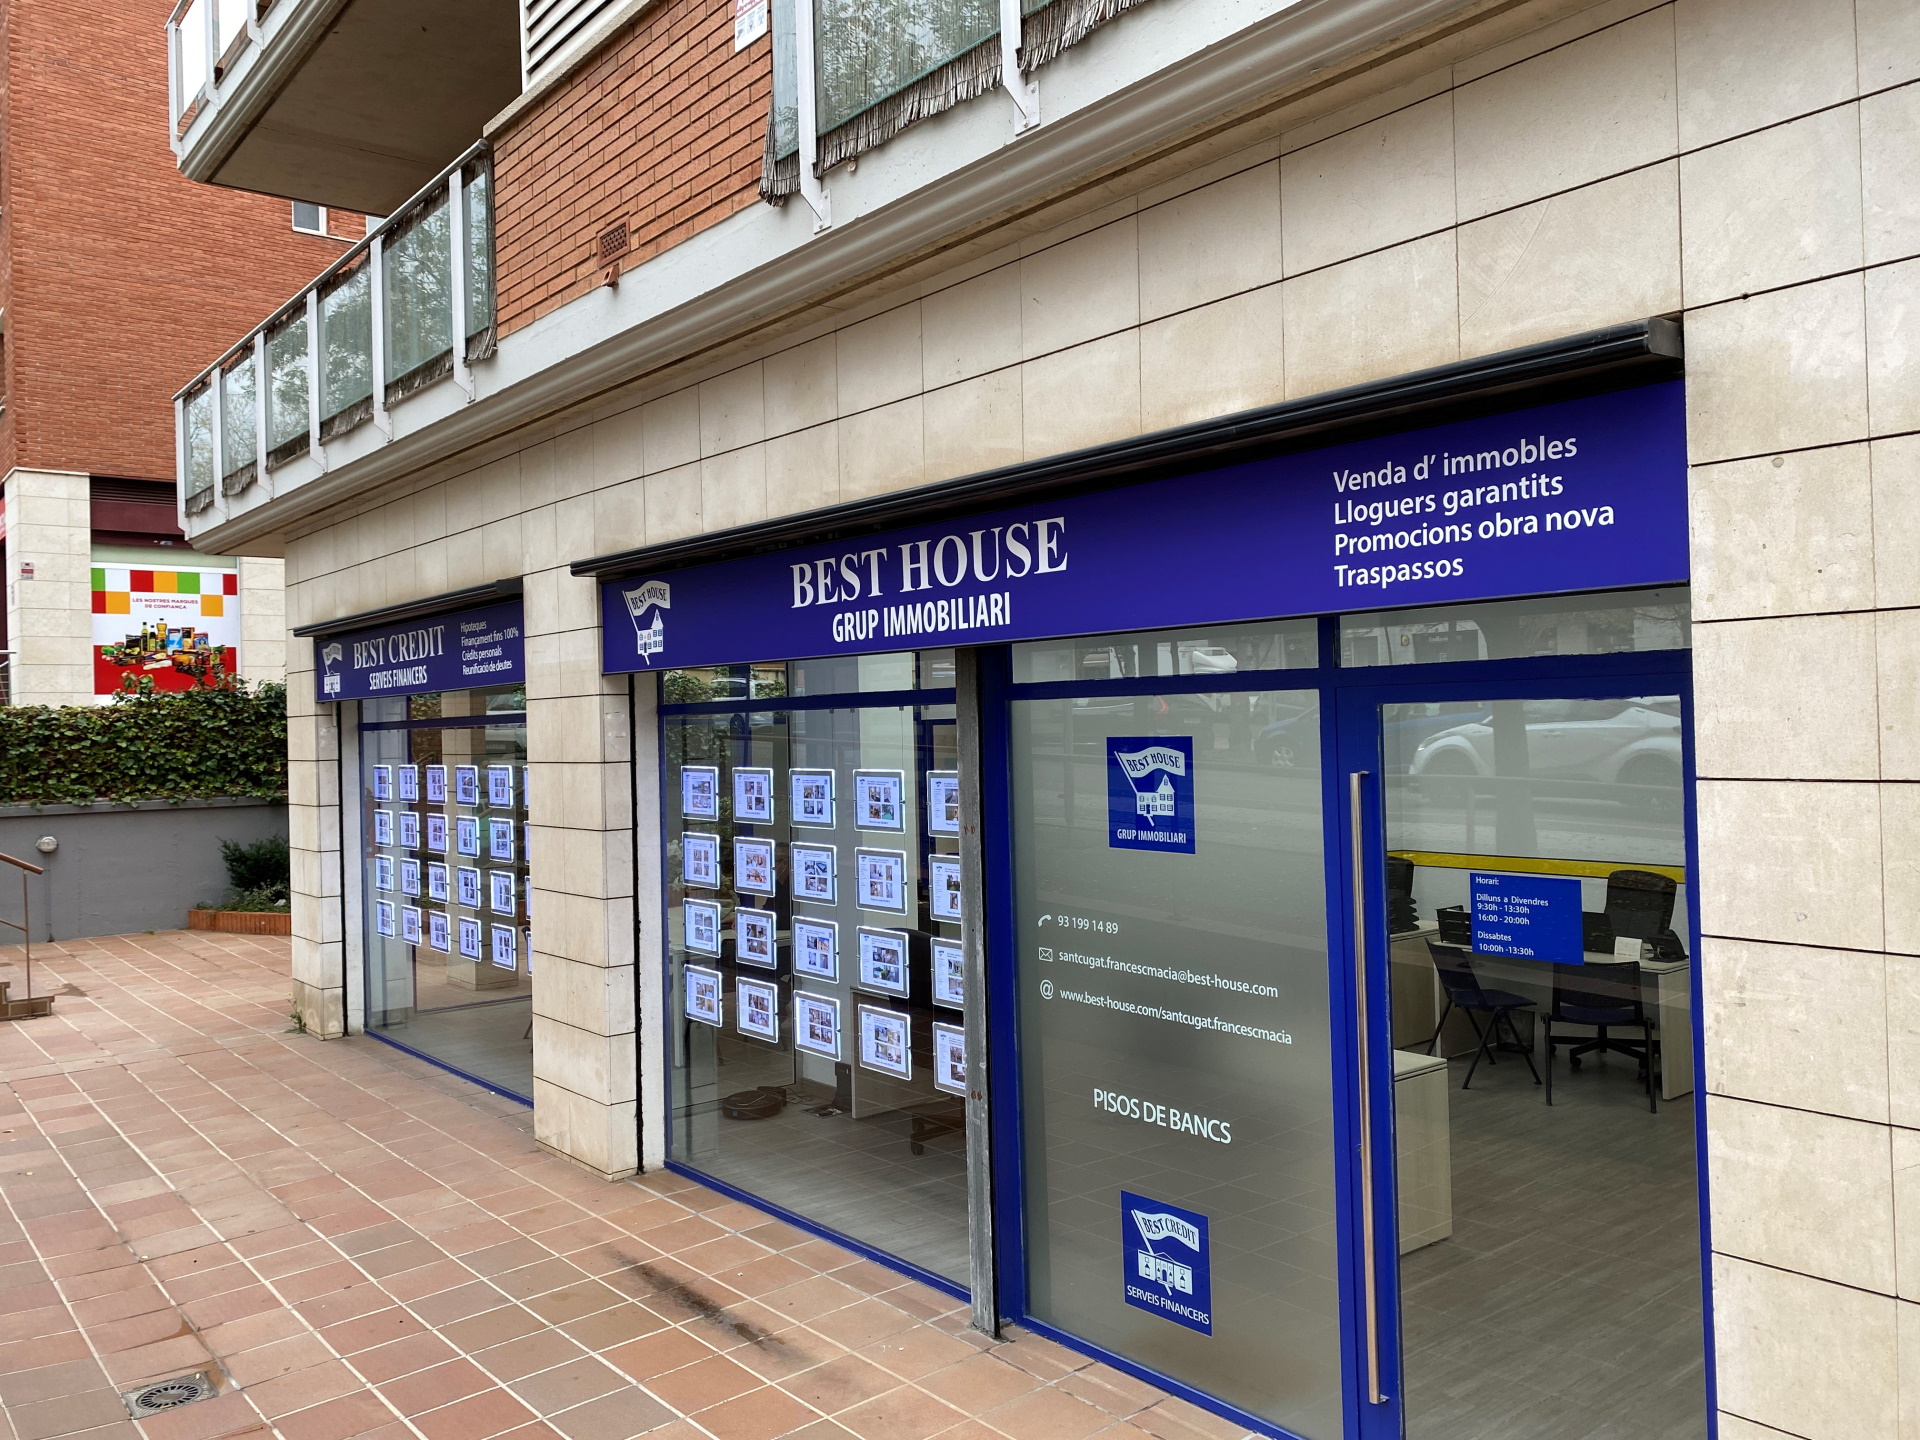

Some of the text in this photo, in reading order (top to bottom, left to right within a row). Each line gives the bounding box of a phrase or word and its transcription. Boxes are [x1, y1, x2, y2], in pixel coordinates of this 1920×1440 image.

[1333, 461, 1406, 493] Venda
[1443, 436, 1577, 476] immobles
[1334, 473, 1563, 525] Lloguers garantits
[1335, 505, 1614, 556] Promocions obra nova
[790, 517, 1068, 608] BEST HOUSE
[1334, 557, 1463, 589] Traspassos
[630, 587, 666, 610] BEST HOUSE
[460, 621, 486, 634] Hipoteques
[832, 592, 1010, 642] GRUP IMMOBILIARI
[353, 638, 385, 669] BEST
[388, 625, 444, 663] CREDIT
[461, 627, 518, 648] Finançament fins 100%
[479, 645, 502, 661] personals
[370, 665, 427, 690] SERVEIS FINANCERS
[490, 661, 495, 672] de
[496, 660, 512, 671] deutes
[1126, 753, 1180, 771] BEST HOUSE
[1117, 829, 1186, 844] GRUP IMMOBILIARI
[1476, 893, 1501, 902] Dilluns
[1511, 896, 1548, 906] Divendres
[1477, 903, 1498, 911] 9:30h
[1505, 905, 1530, 914] 13:30h
[1058, 915, 1118, 934] 93 199 14 89
[1478, 914, 1498, 922] 16:00
[1504, 916, 1530, 925] 20:00h
[1478, 931, 1512, 941] Dissabtes
[1479, 944, 1503, 953] 10:00h
[1059, 952, 1278, 998] santcugat.francescmacia@best-house.com
[1060, 990, 1292, 1045] www.best-house.com/santcugat.francescmacia
[1094, 1088, 1232, 1144] PISOS DE BANCS
[1141, 1217, 1196, 1244] BEST CREDIT
[1127, 1285, 1209, 1324] SERVEIS FINANCERS
